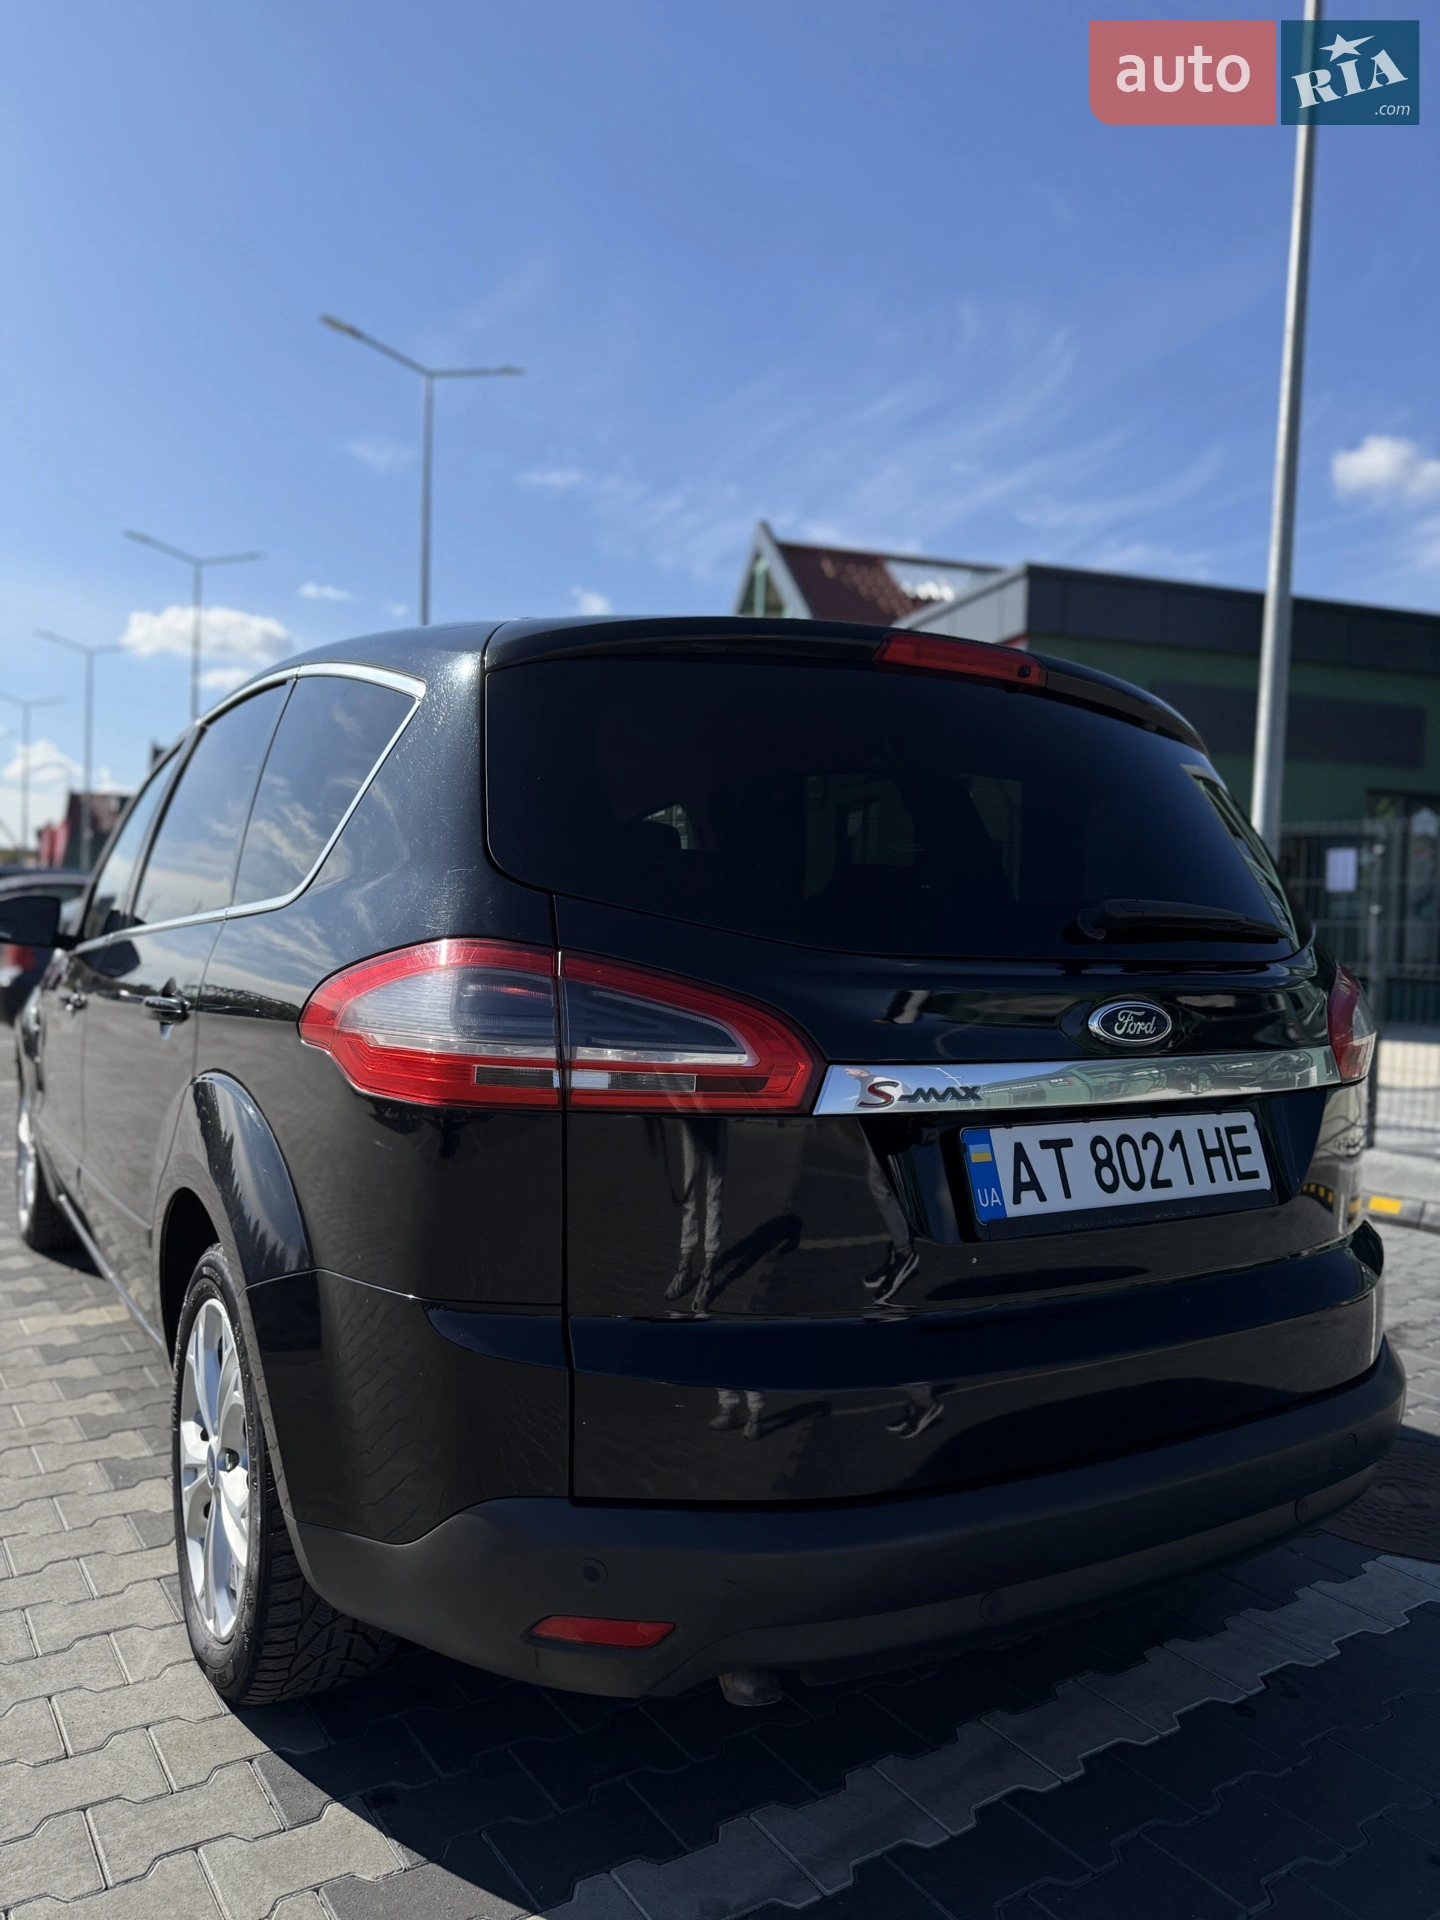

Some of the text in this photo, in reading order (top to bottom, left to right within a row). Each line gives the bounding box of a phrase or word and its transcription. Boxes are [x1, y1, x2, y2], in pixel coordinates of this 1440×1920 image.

[1113, 1009, 1157, 1036] Ford
[1012, 1124, 1261, 1206] AT 8021 HE
[977, 1187, 1002, 1208] UA
